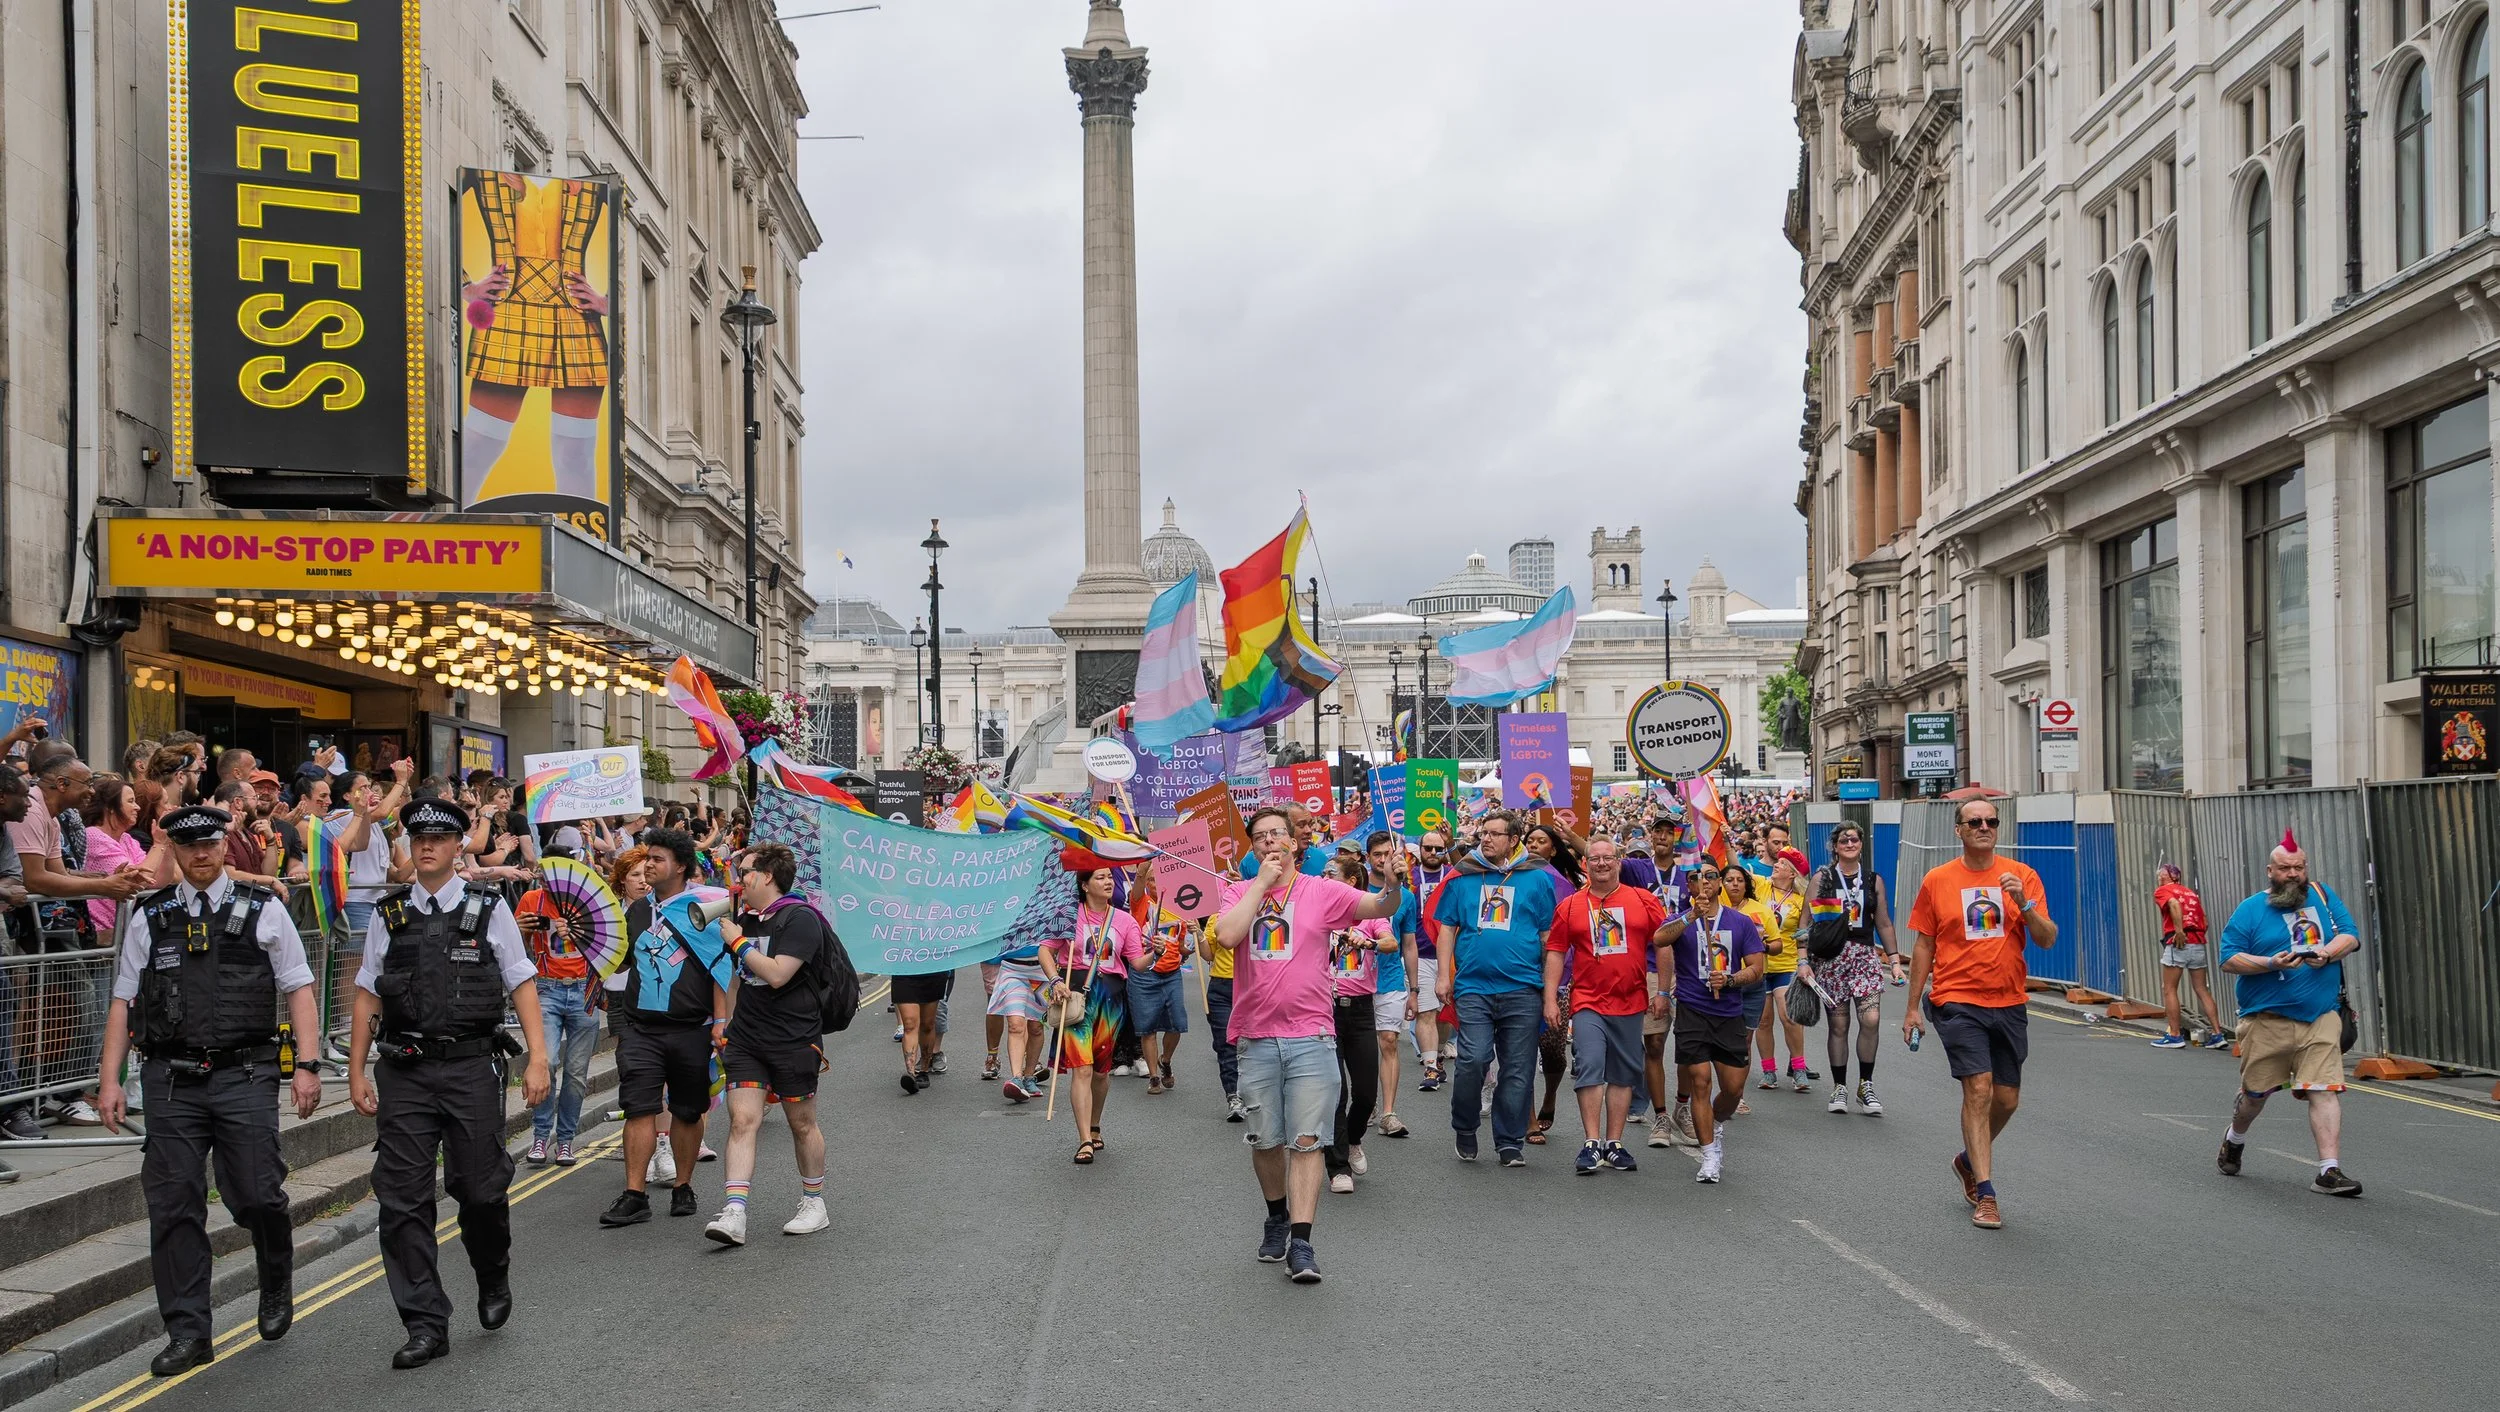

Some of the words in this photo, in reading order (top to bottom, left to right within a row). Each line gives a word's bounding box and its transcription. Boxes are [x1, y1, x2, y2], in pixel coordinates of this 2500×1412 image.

[234, 0, 366, 411] LUELESS
[180, 534, 375, 562] NON-STOP
[384, 538, 520, 565] PARTY'
[306, 568, 328, 576] RADIO
[329, 569, 352, 577] TIMES
[634, 584, 683, 637] TRAFALGAR
[684, 609, 718, 653] THEATRE
[187, 665, 199, 681] TO
[200, 669, 222, 686] YOUR
[223, 674, 243, 690] NEW
[243, 678, 284, 699] FAVOURITE
[2430, 684, 2496, 696] WALKERS
[2430, 698, 2445, 707] OF
[2447, 697, 2497, 706] WHITEHALL
[1509, 723, 1557, 733] Timeless
[1639, 715, 1717, 735] TRANSPORT
[1509, 737, 1541, 748] funky
[1639, 738, 1664, 750] FOR
[1666, 729, 1722, 747] LONDON
[1090, 753, 1127, 761] TRANSPORT
[1510, 750, 1553, 760] LGBTQ+
[1917, 750, 1943, 758] MONEY
[538, 762, 550, 771] No
[551, 755, 570, 767] need
[571, 753, 581, 764] to
[1105, 759, 1130, 767] LONDON
[1157, 759, 1205, 770] LGBTQ+
[1911, 760, 1950, 769] EXCHANGE
[572, 762, 591, 777] TAP
[602, 761, 623, 772] OUT
[1296, 767, 1324, 775] Thriving
[1415, 768, 1444, 778] Totally
[1675, 770, 1696, 778] PRIDE
[1146, 773, 1215, 786] COLLEAGUE
[1415, 779, 1427, 788] fly
[543, 780, 582, 797] TRUE
[587, 778, 631, 798] SELF
[1299, 783, 1324, 791] LGBTQ+
[1415, 790, 1443, 798] LGBTQ
[547, 799, 577, 811] travel
[580, 801, 589, 809] as
[589, 800, 607, 814] you
[609, 798, 625, 806] are
[1237, 802, 1260, 812] THOUT
[1156, 836, 1189, 850] Tasteful
[951, 836, 1040, 867] PARENTS
[840, 855, 896, 881] AND
[905, 858, 1033, 888] GUARDIANS
[1159, 861, 1187, 874] LGBTQ
[867, 900, 997, 921] COLLEAGUE
[872, 921, 983, 942] NETWORK
[883, 945, 960, 963] GROUP
